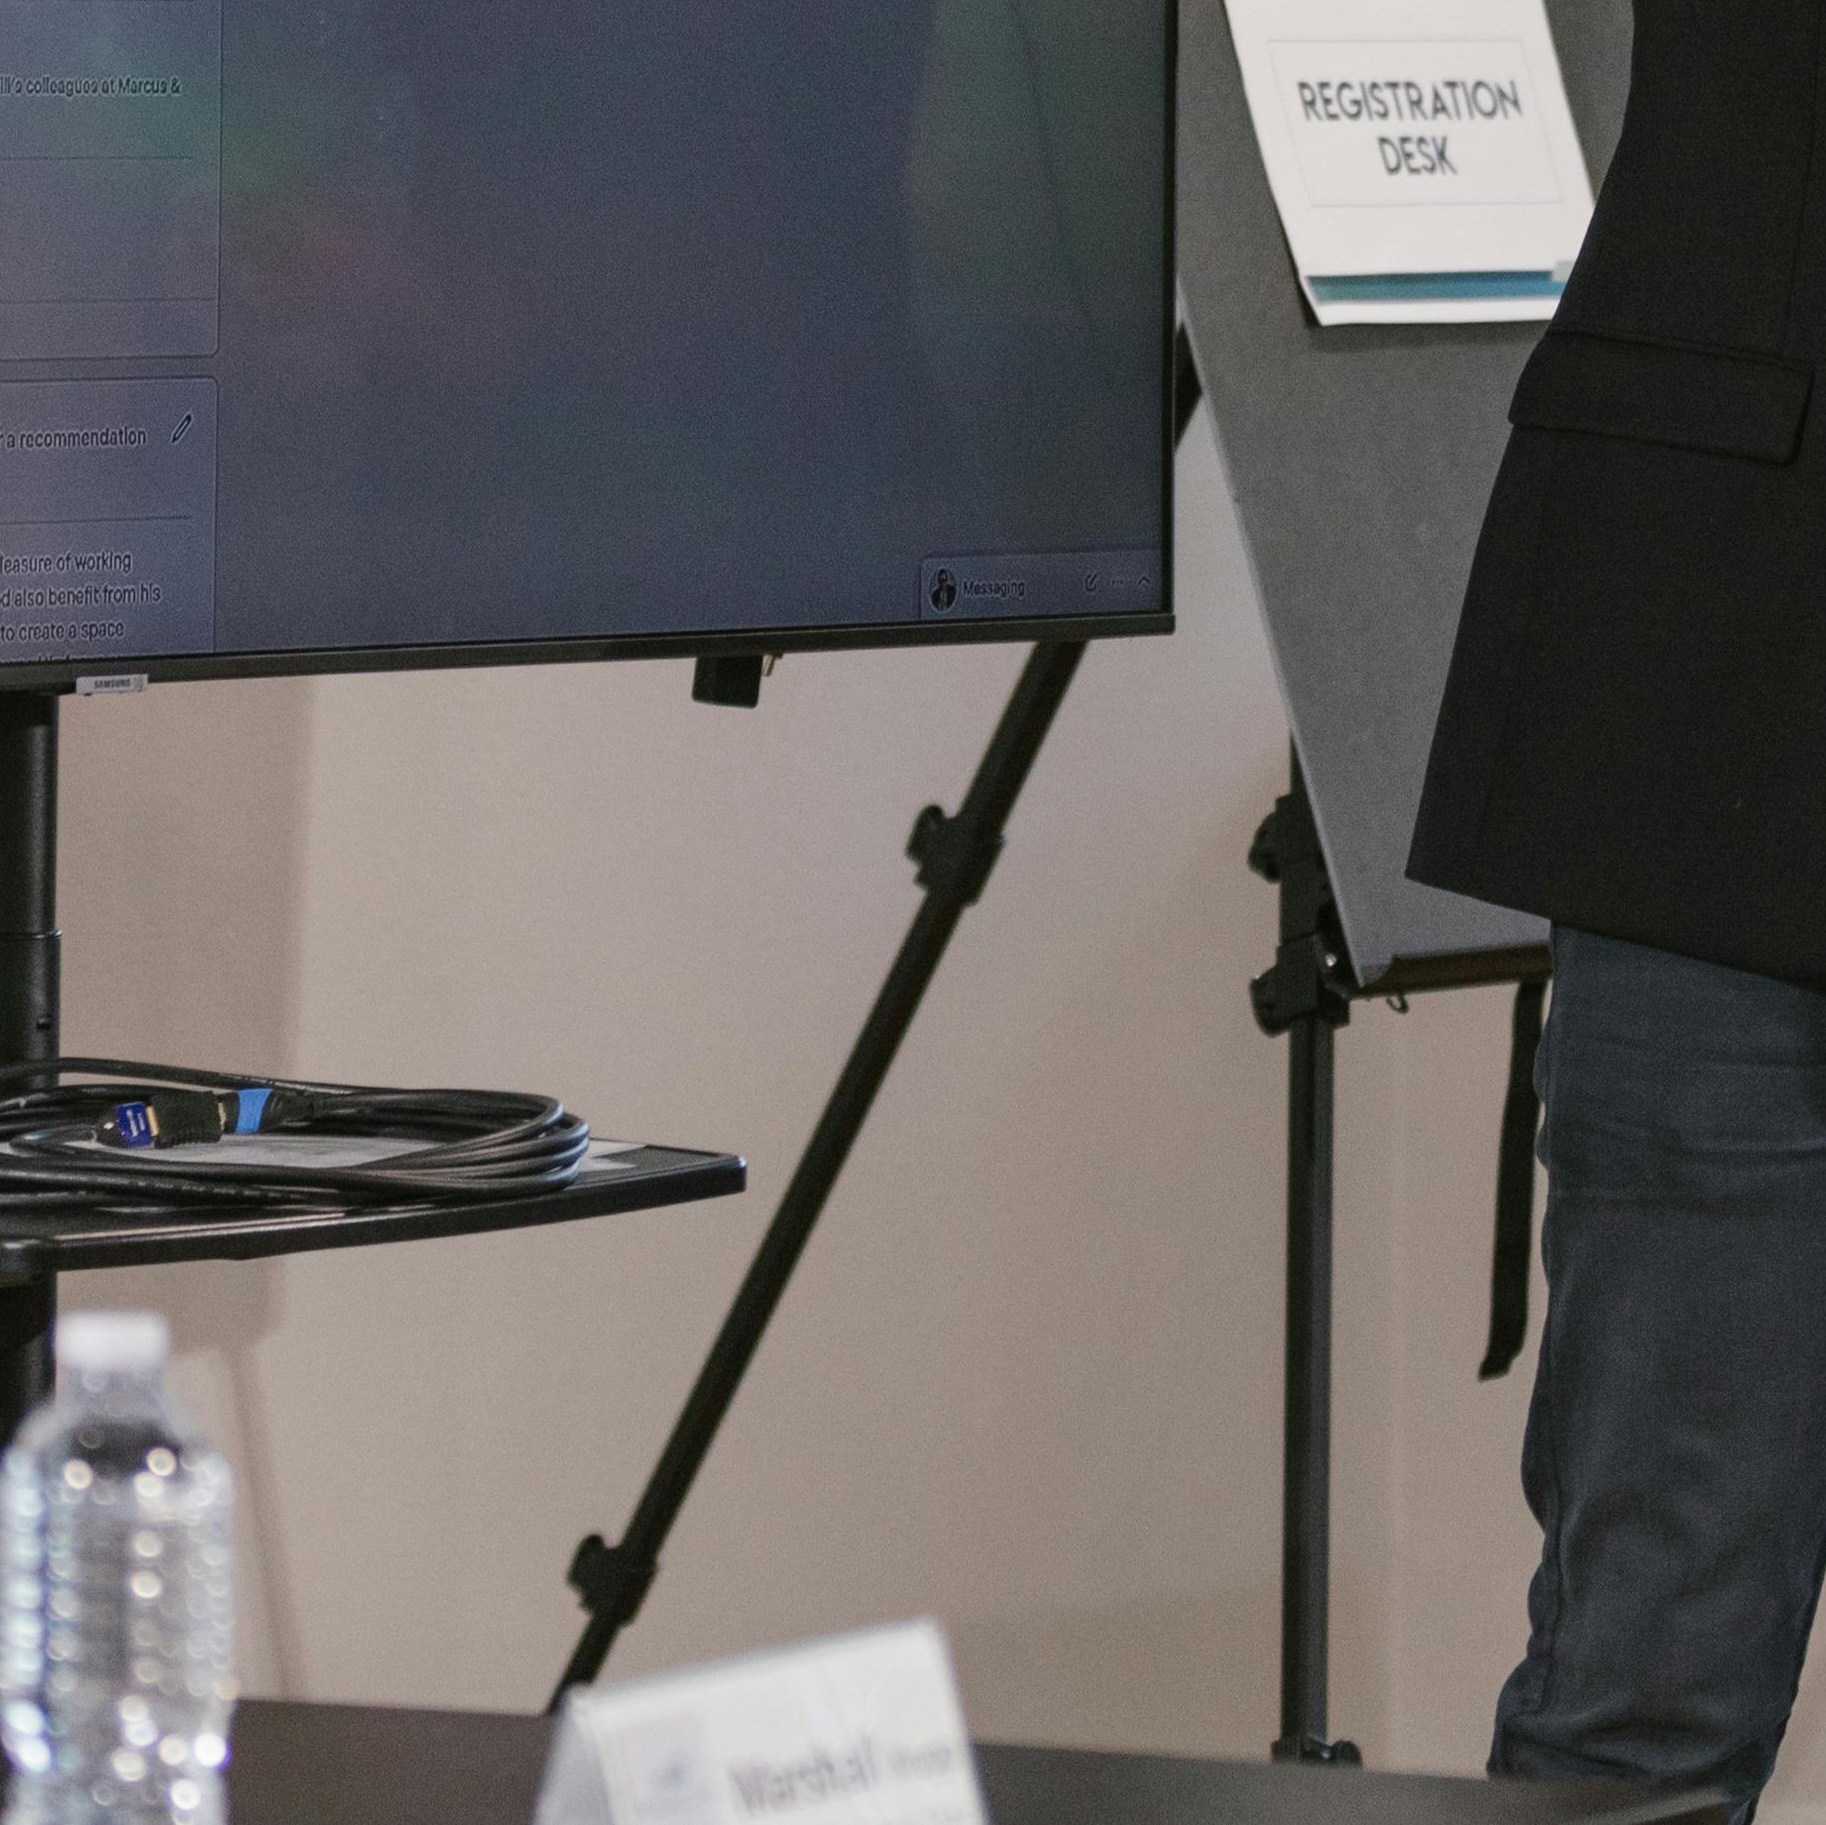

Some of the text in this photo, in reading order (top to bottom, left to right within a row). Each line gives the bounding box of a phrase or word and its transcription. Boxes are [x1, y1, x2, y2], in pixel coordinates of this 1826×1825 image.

[1296, 80, 1522, 122] REGISTRATION
[1377, 135, 1459, 176] DESK
[7, 434, 15, 448] a
[20, 429, 145, 448] recommendation
[56, 553, 70, 572] of
[75, 554, 130, 575] working
[963, 577, 1026, 600] Messaging
